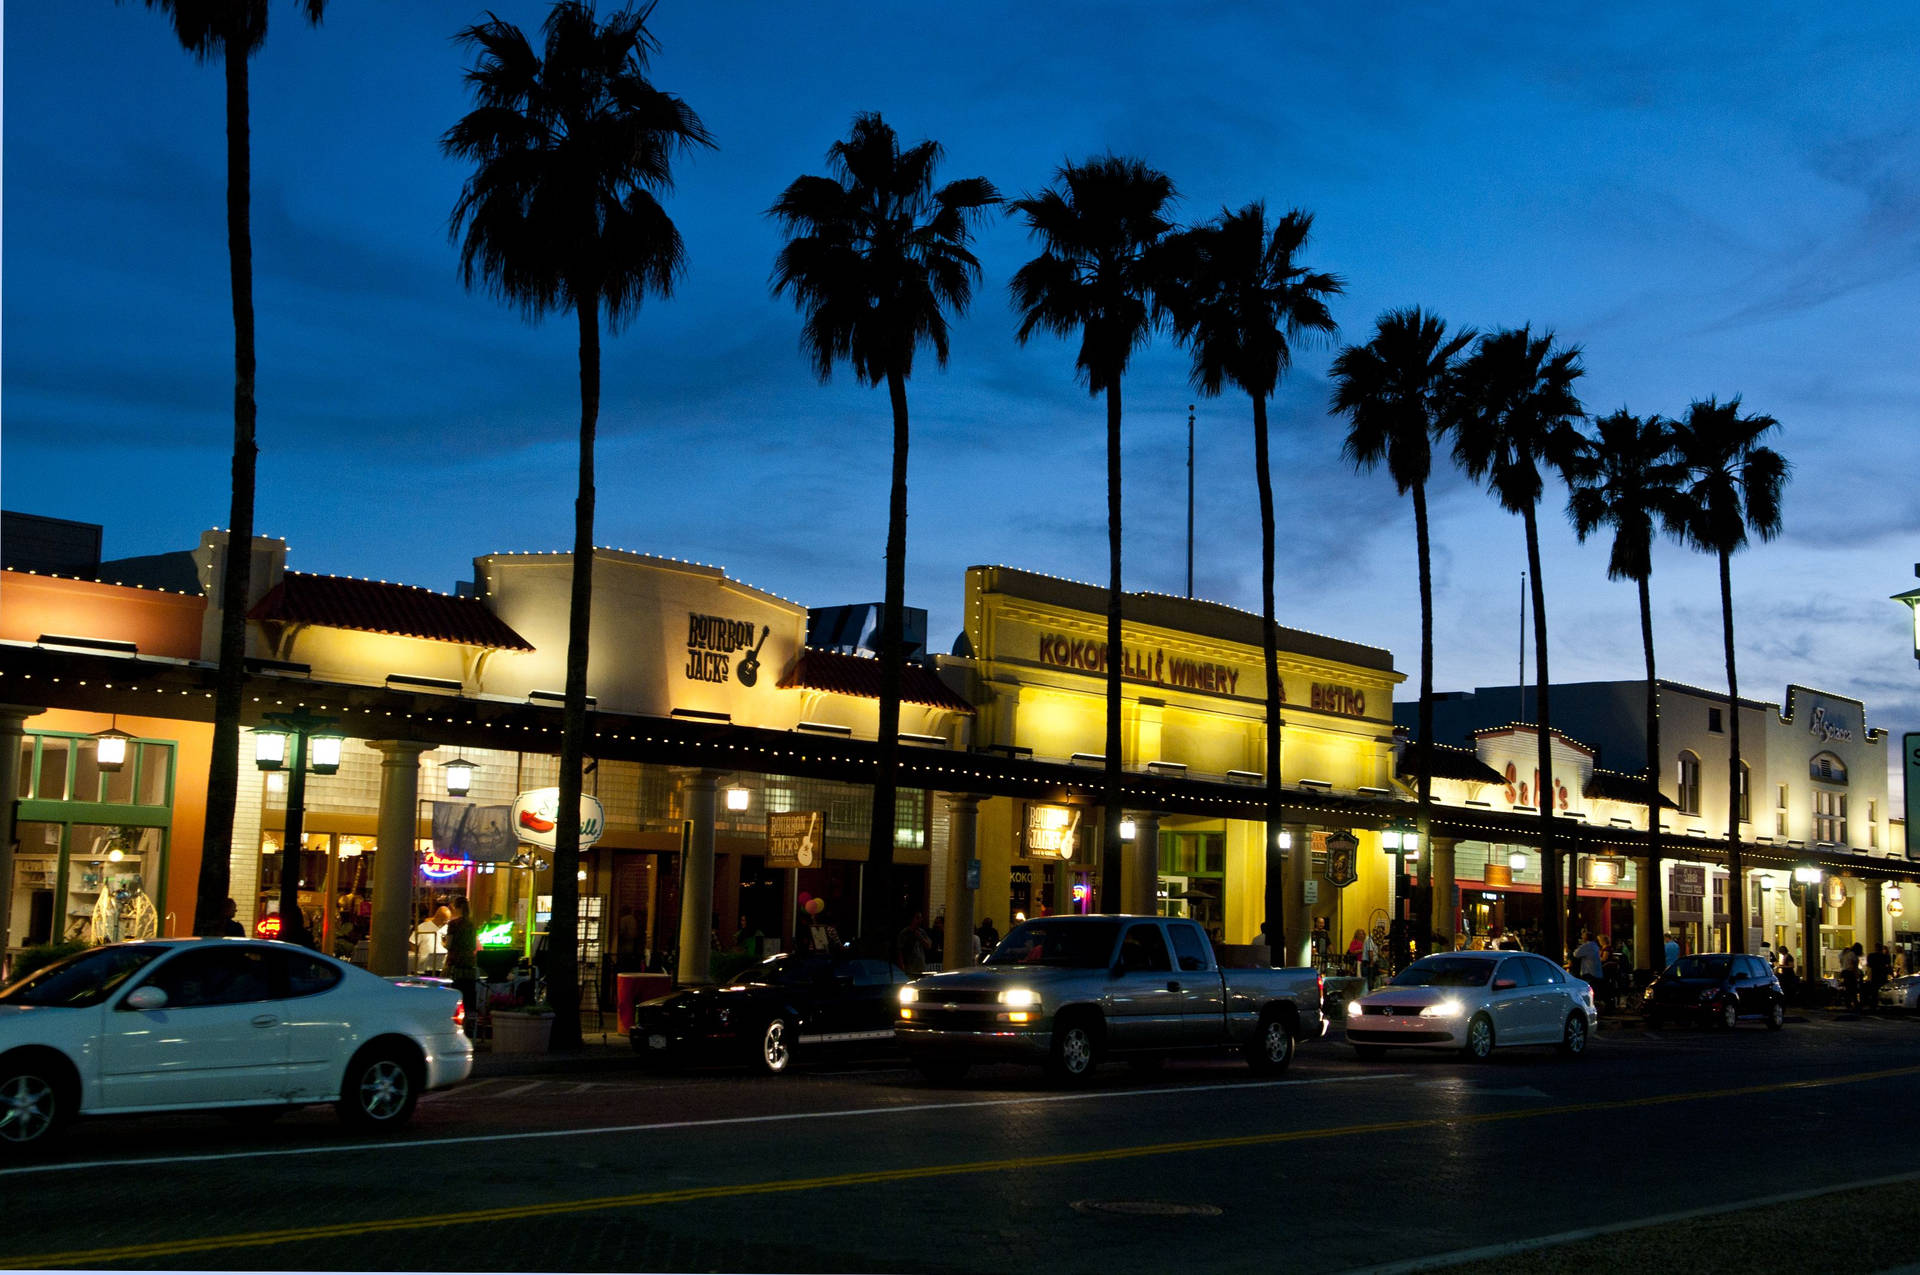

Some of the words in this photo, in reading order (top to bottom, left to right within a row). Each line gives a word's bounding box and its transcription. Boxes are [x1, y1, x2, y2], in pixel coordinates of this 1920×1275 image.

[687, 612, 754, 653] BOURBON
[1040, 631, 1152, 682] KOKOPLLI
[1168, 655, 1239, 694] WINERY
[1311, 682, 1365, 716] BISTRO
[770, 815, 806, 837] BOURBON
